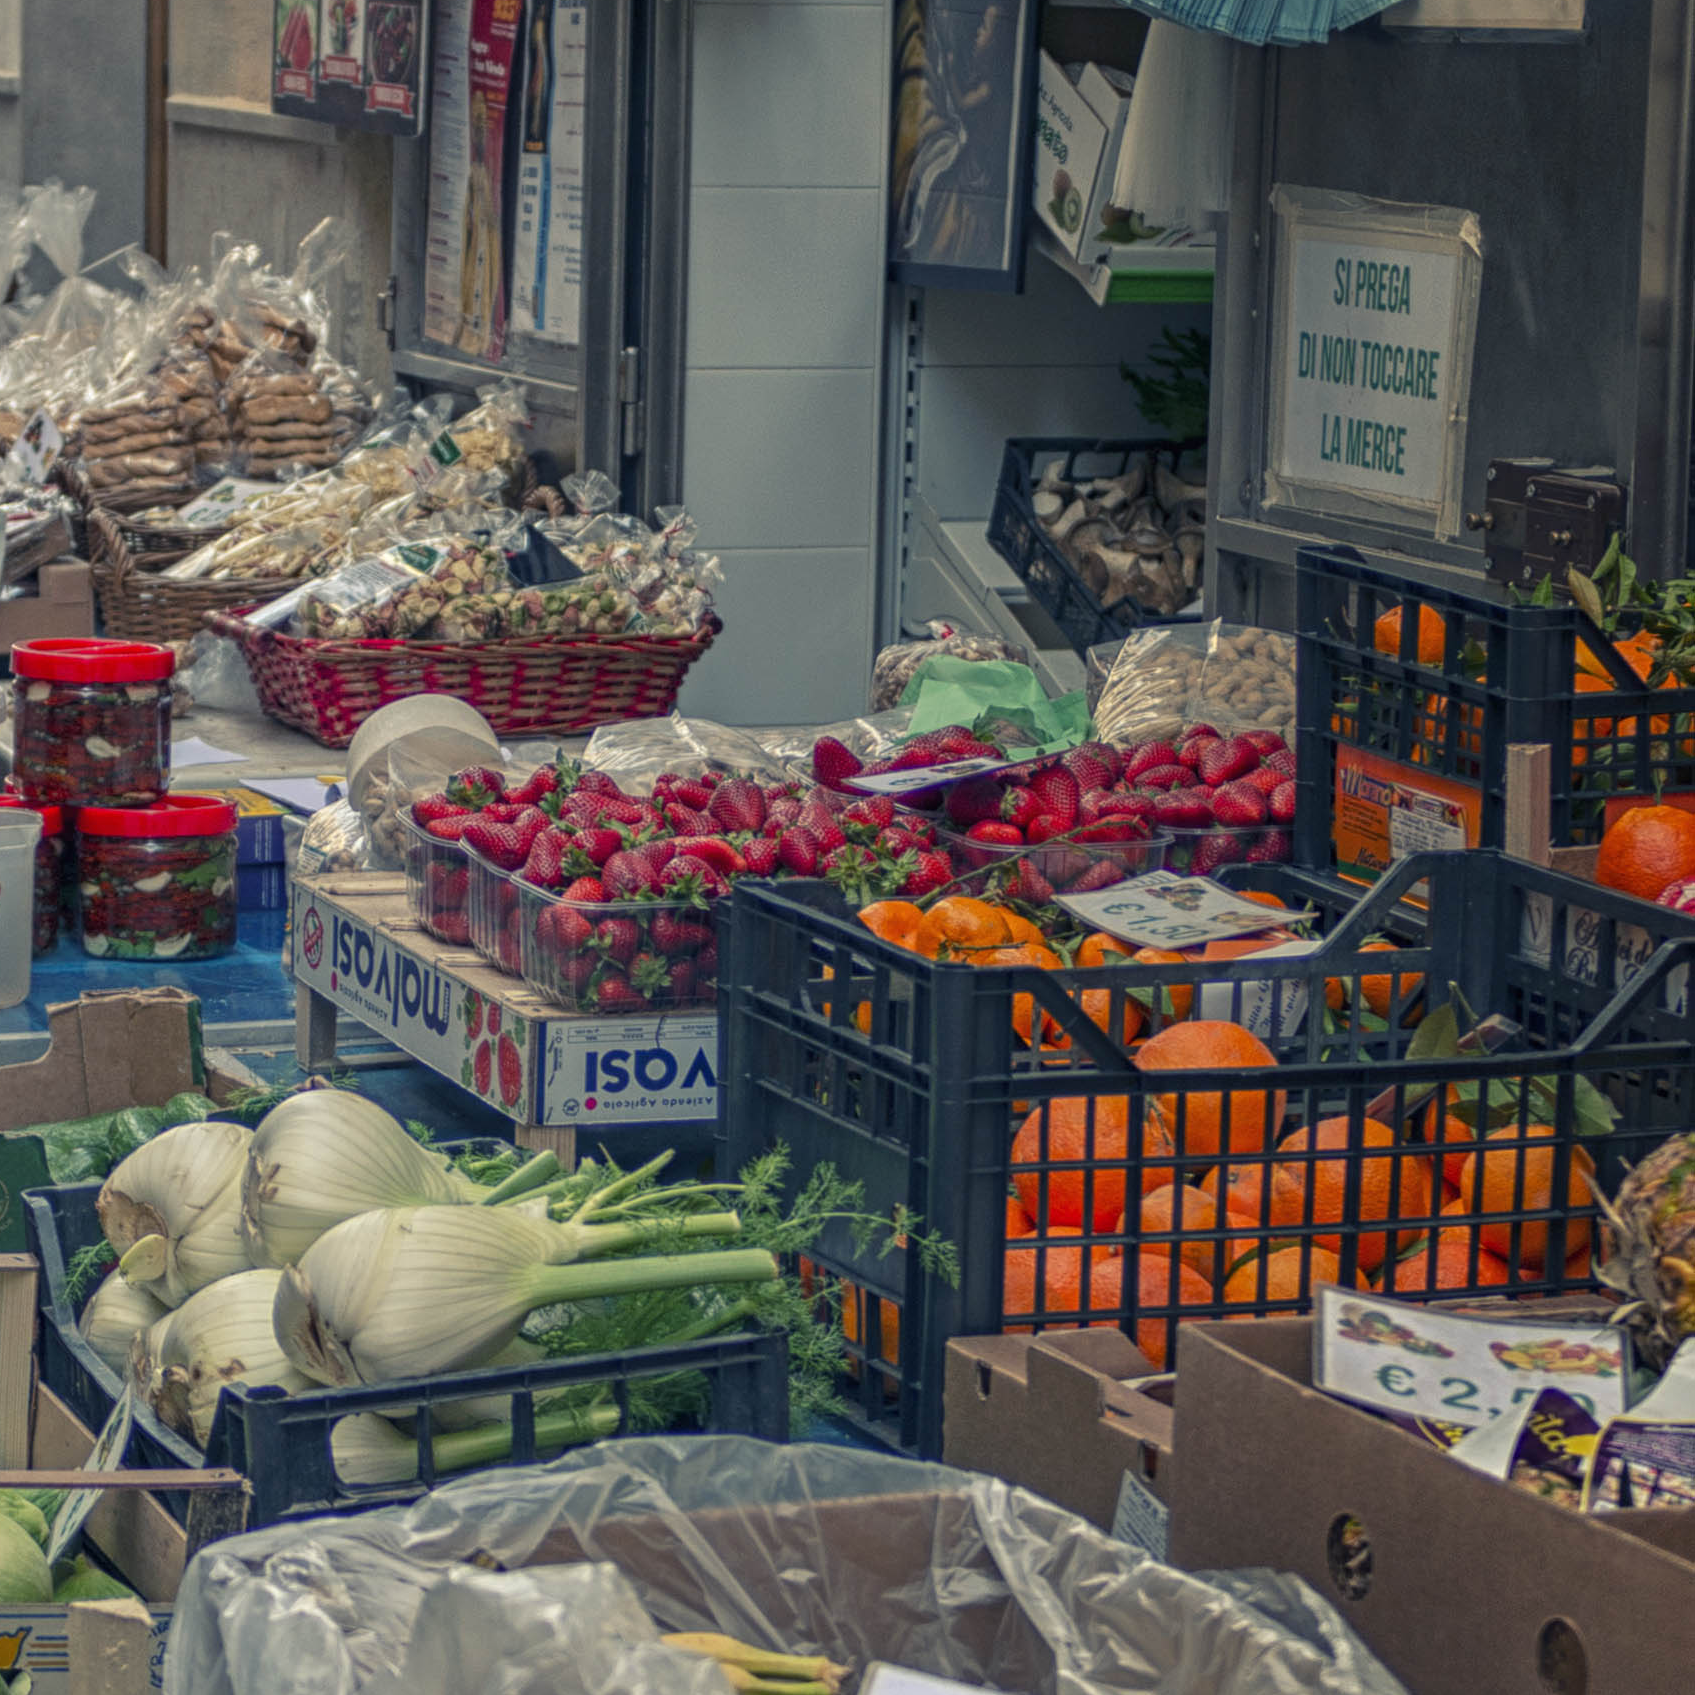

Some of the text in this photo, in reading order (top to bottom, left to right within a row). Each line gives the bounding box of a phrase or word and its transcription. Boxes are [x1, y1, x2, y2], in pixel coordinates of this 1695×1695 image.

[1333, 257, 1411, 315] SI PREGA
[1298, 330, 1441, 401] DI NON TOCCARE
[1320, 412, 1408, 476] LA MERCE
[1126, 915, 1209, 940] 1,50
[331, 914, 451, 1037] malvasi
[584, 1046, 718, 1111] vasi
[603, 1096, 714, 1110] Azienda Agricola
[1374, 1364, 1417, 1397] €
